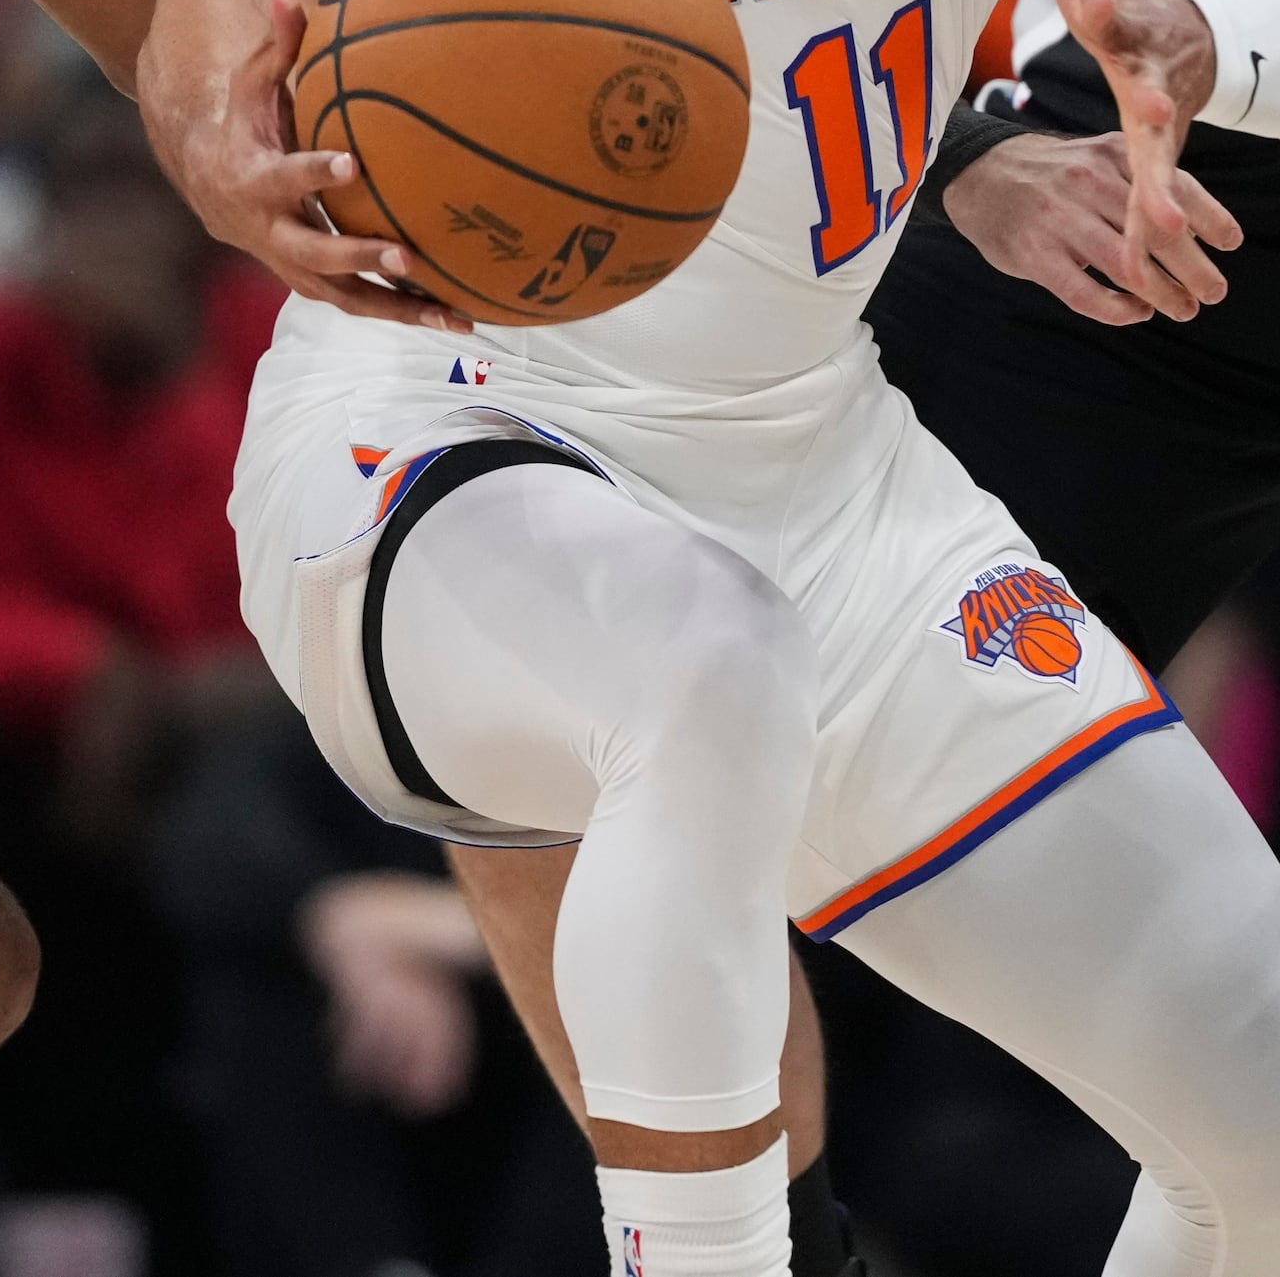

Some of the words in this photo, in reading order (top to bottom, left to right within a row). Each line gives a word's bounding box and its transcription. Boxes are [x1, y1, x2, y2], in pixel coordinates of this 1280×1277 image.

[974, 569, 996, 590] NEW
[991, 563, 1024, 577] YORK
[959, 567, 1085, 660] KNICKS
